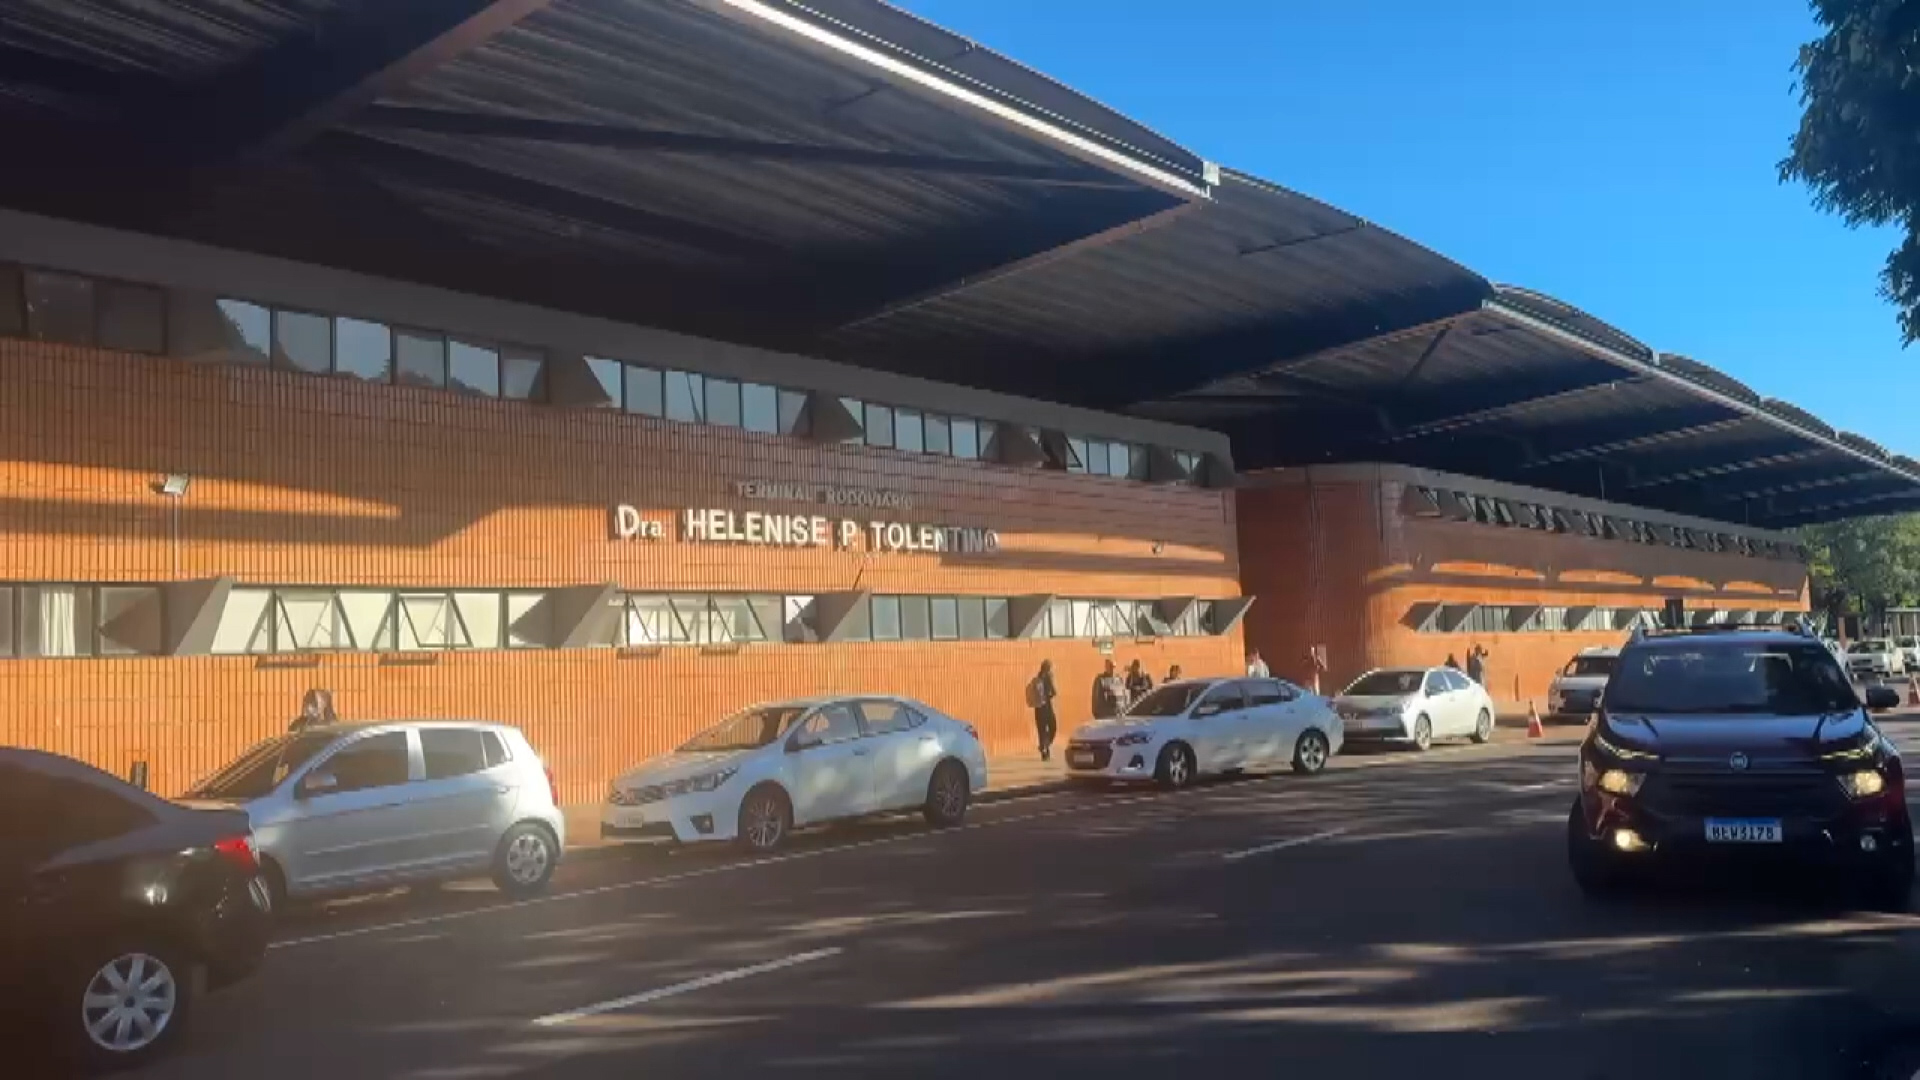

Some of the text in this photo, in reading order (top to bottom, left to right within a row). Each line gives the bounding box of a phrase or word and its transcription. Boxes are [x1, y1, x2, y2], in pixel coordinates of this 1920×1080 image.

[737, 480, 812, 501] TERMINAL
[687, 509, 828, 545] HELENISE
[870, 521, 999, 553] TOLENTINO
